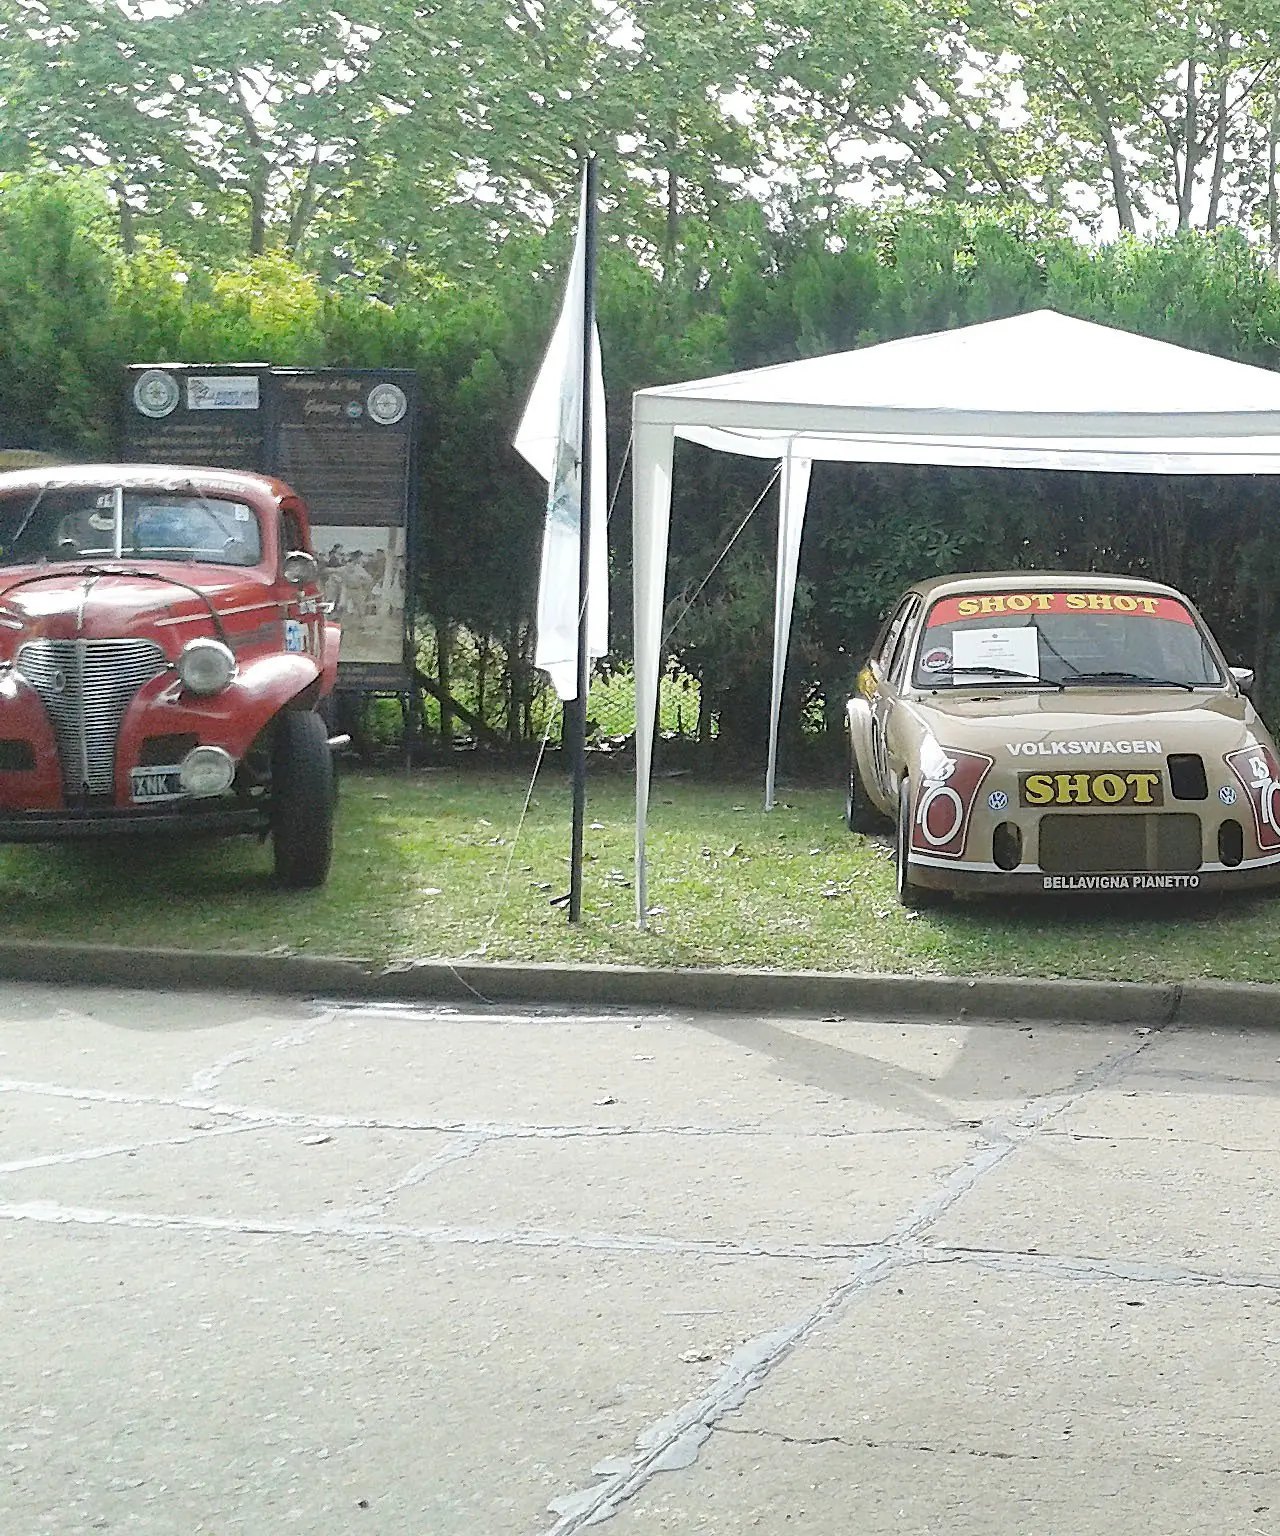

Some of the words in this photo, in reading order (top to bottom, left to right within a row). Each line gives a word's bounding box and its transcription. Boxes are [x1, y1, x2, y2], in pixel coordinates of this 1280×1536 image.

[958, 594, 1055, 616] SHOT
[1066, 594, 1160, 614] SHOT
[1006, 741, 1162, 756] VOLKSWAGEN
[1025, 774, 1159, 804] SHOT
[1043, 876, 1129, 889] BELLAVIGNA
[1133, 875, 1199, 888] PIANETTO
